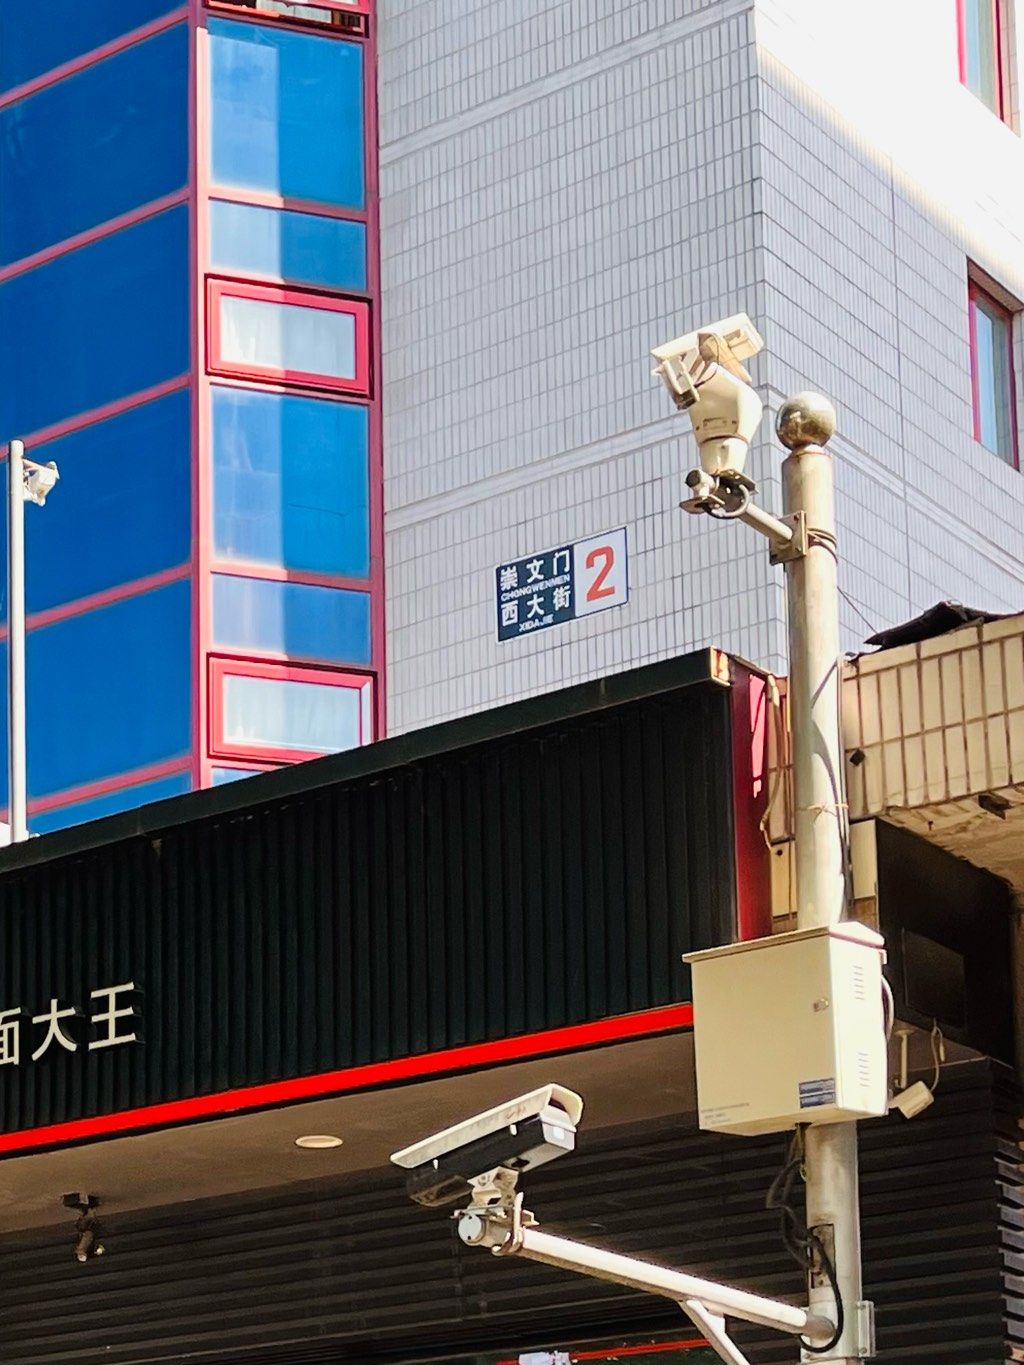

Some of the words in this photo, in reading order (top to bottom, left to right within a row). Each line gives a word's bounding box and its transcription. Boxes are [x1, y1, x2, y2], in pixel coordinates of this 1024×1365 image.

[500, 549, 570, 592] 崇文门
[500, 574, 571, 602] CHONGWENMEN
[585, 545, 616, 602] 2
[500, 585, 571, 627] 西大街
